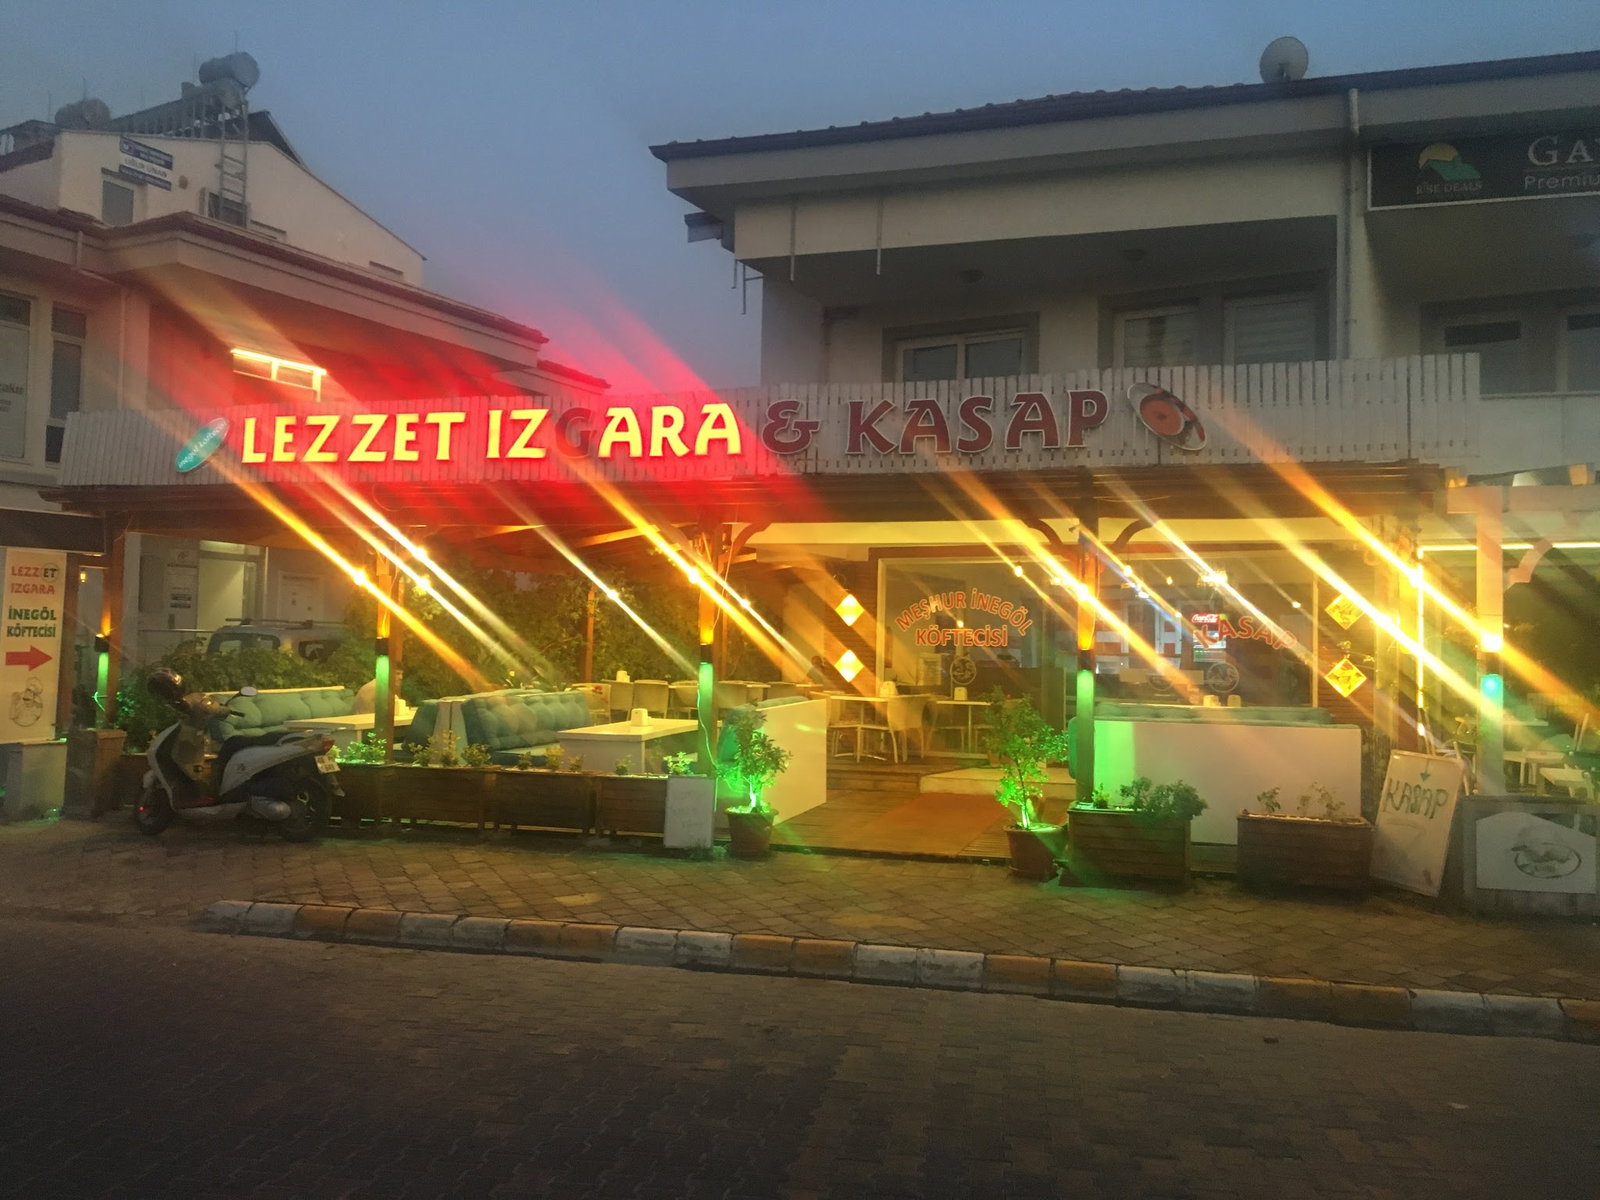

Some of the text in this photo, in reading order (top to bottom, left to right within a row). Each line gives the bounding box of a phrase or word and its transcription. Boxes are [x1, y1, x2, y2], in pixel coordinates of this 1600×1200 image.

[1527, 135, 1600, 167] GA
[241, 389, 1110, 463] LEZZET IZGARA & KASAP
[10, 583, 56, 596] IZGARA
[8, 605, 57, 621] İNEGÖL
[895, 587, 1033, 637] MEŞHUR İNEGÖL
[6, 622, 57, 638] KÖFTECİSİ
[915, 624, 1008, 647] KÖFTECİSİ
[1193, 615, 1298, 650] KASAP
[1384, 778, 1448, 819] KASAP
